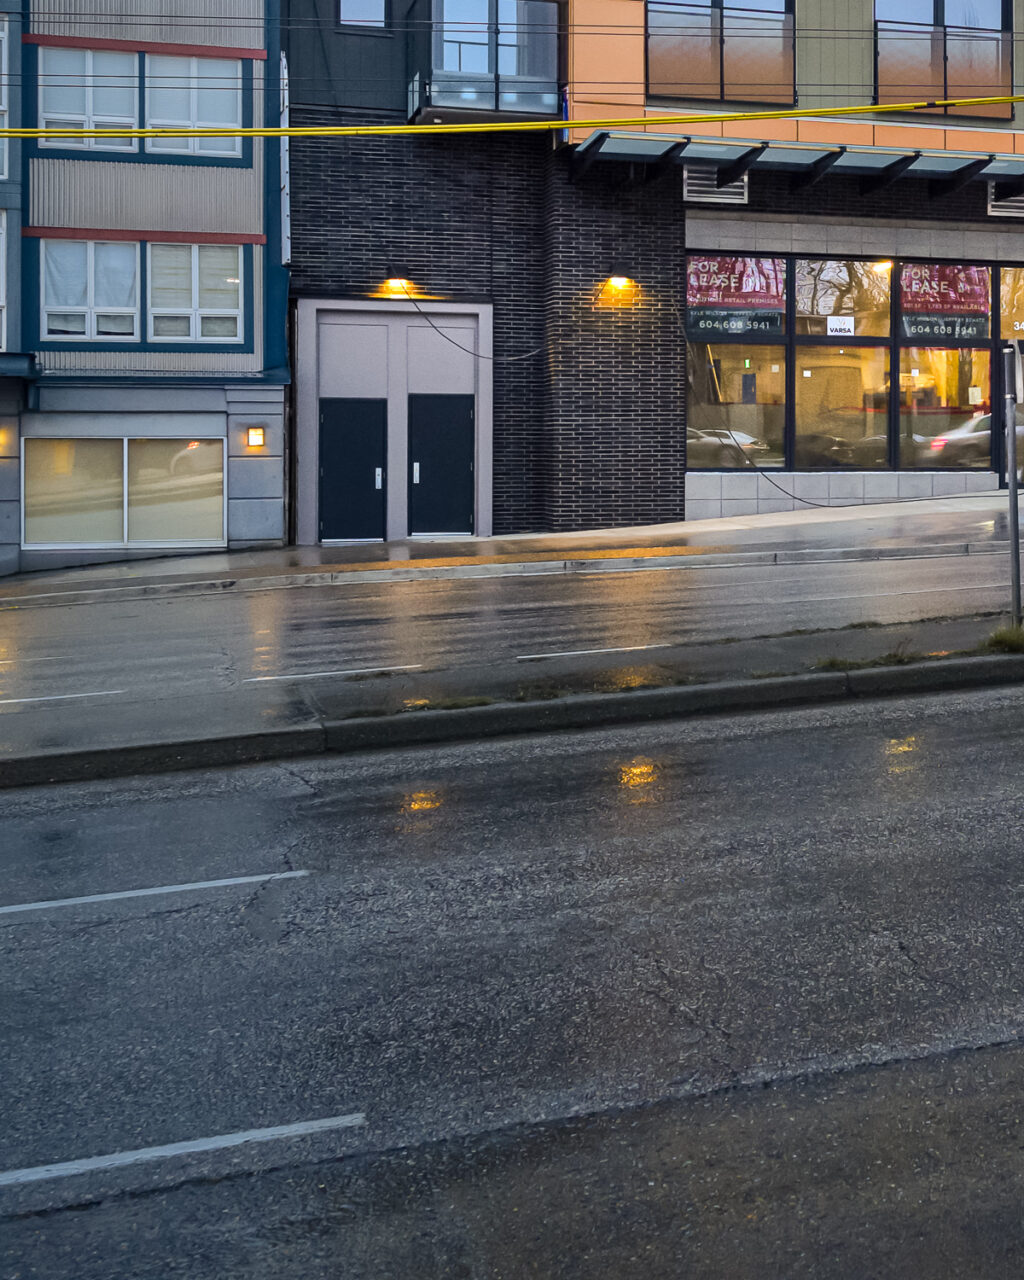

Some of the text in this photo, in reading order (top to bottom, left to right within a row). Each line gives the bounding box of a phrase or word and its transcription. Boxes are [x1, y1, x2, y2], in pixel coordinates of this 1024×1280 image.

[689, 261, 719, 273] FOR
[902, 268, 930, 280] FOR
[689, 274, 740, 287] LEASE
[902, 280, 949, 293] LEASE
[699, 320, 770, 329] 604 608 5941
[933, 326, 952, 334] 608
[955, 326, 977, 334] 5941
